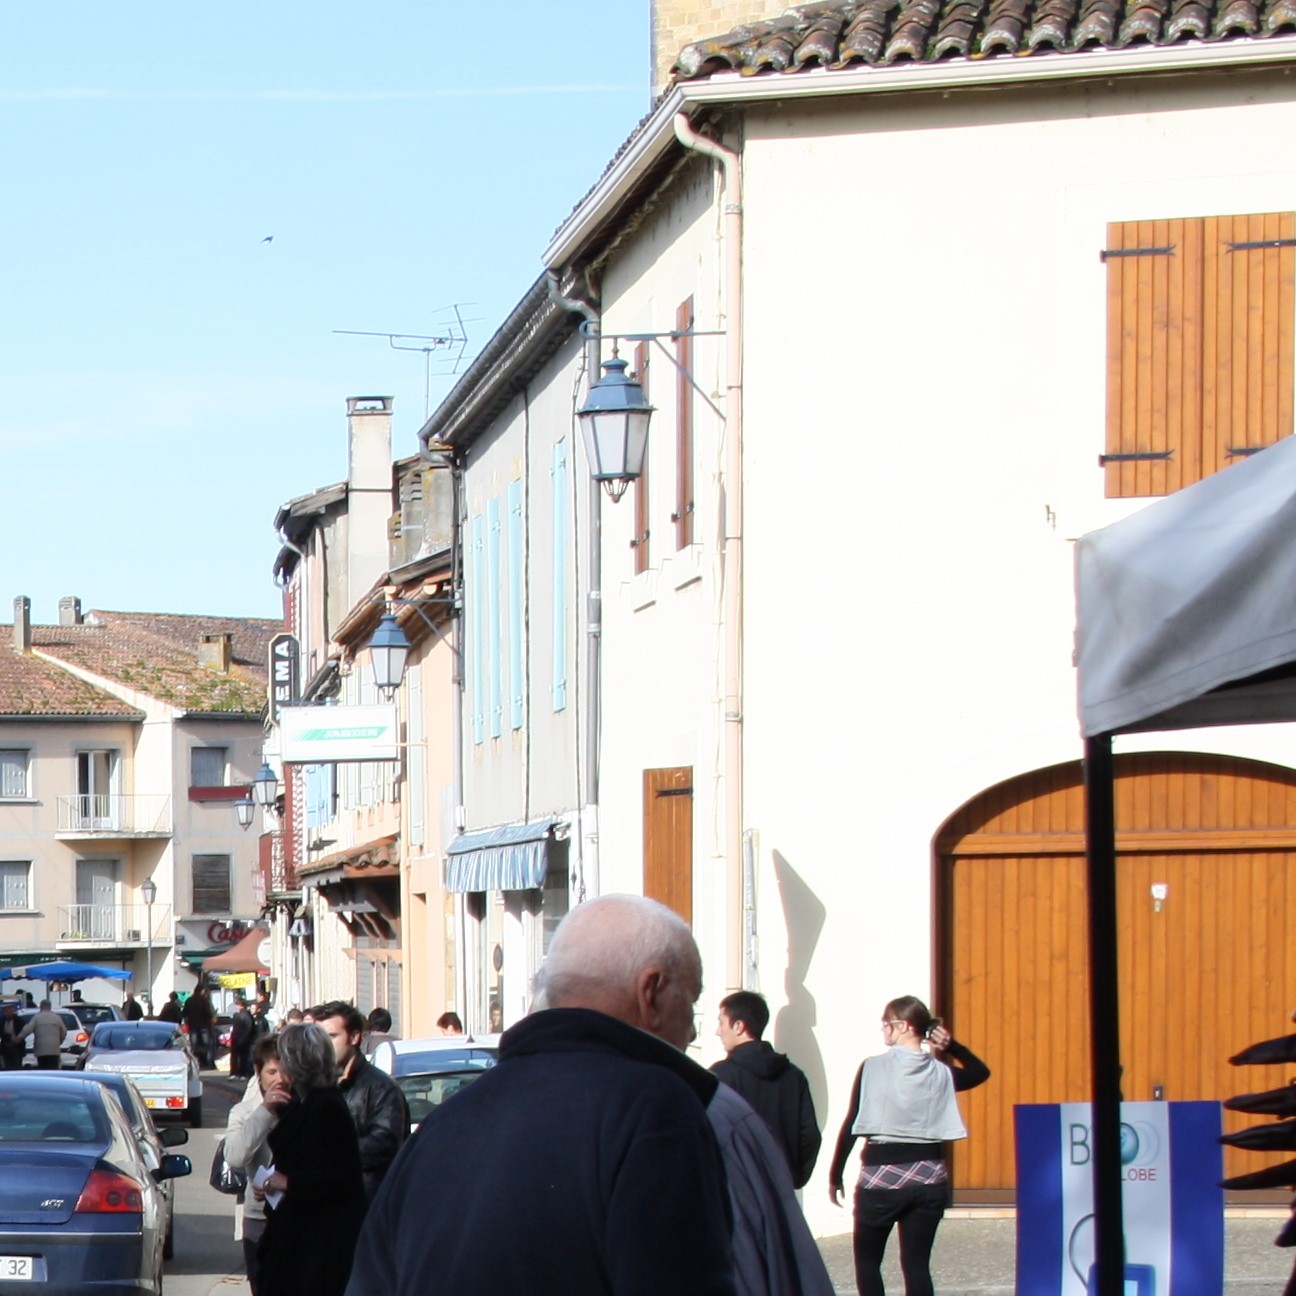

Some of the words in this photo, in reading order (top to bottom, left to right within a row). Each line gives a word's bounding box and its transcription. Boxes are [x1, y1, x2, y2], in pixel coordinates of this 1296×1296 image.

[274, 640, 290, 720] EMA
[323, 728, 379, 739] JARDIN
[8, 1260, 27, 1275] 32
